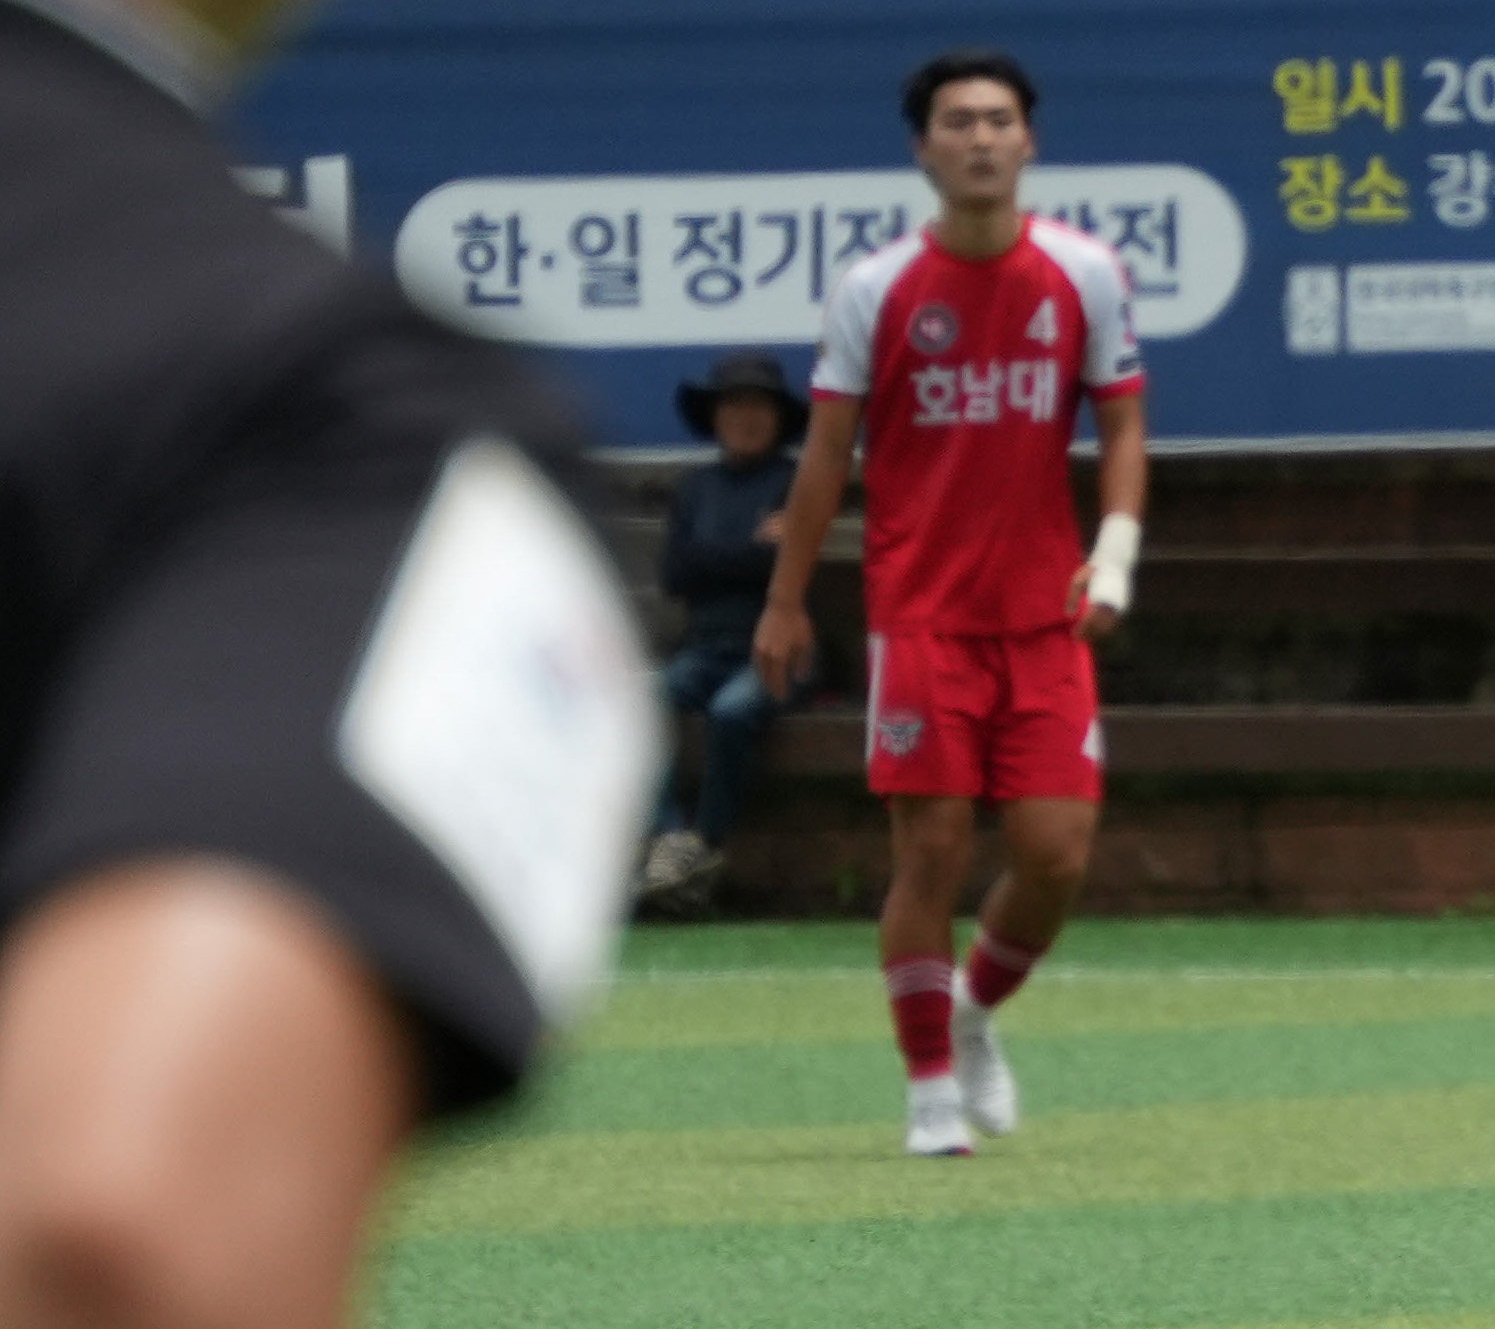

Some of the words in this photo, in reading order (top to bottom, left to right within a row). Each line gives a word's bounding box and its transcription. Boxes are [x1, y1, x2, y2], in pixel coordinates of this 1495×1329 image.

[1272, 57, 1402, 134] 일시
[1277, 154, 1411, 231] 장소
[452, 210, 642, 308] 한·일
[1025, 297, 1059, 347] 4
[909, 358, 1059, 427] 호남대
